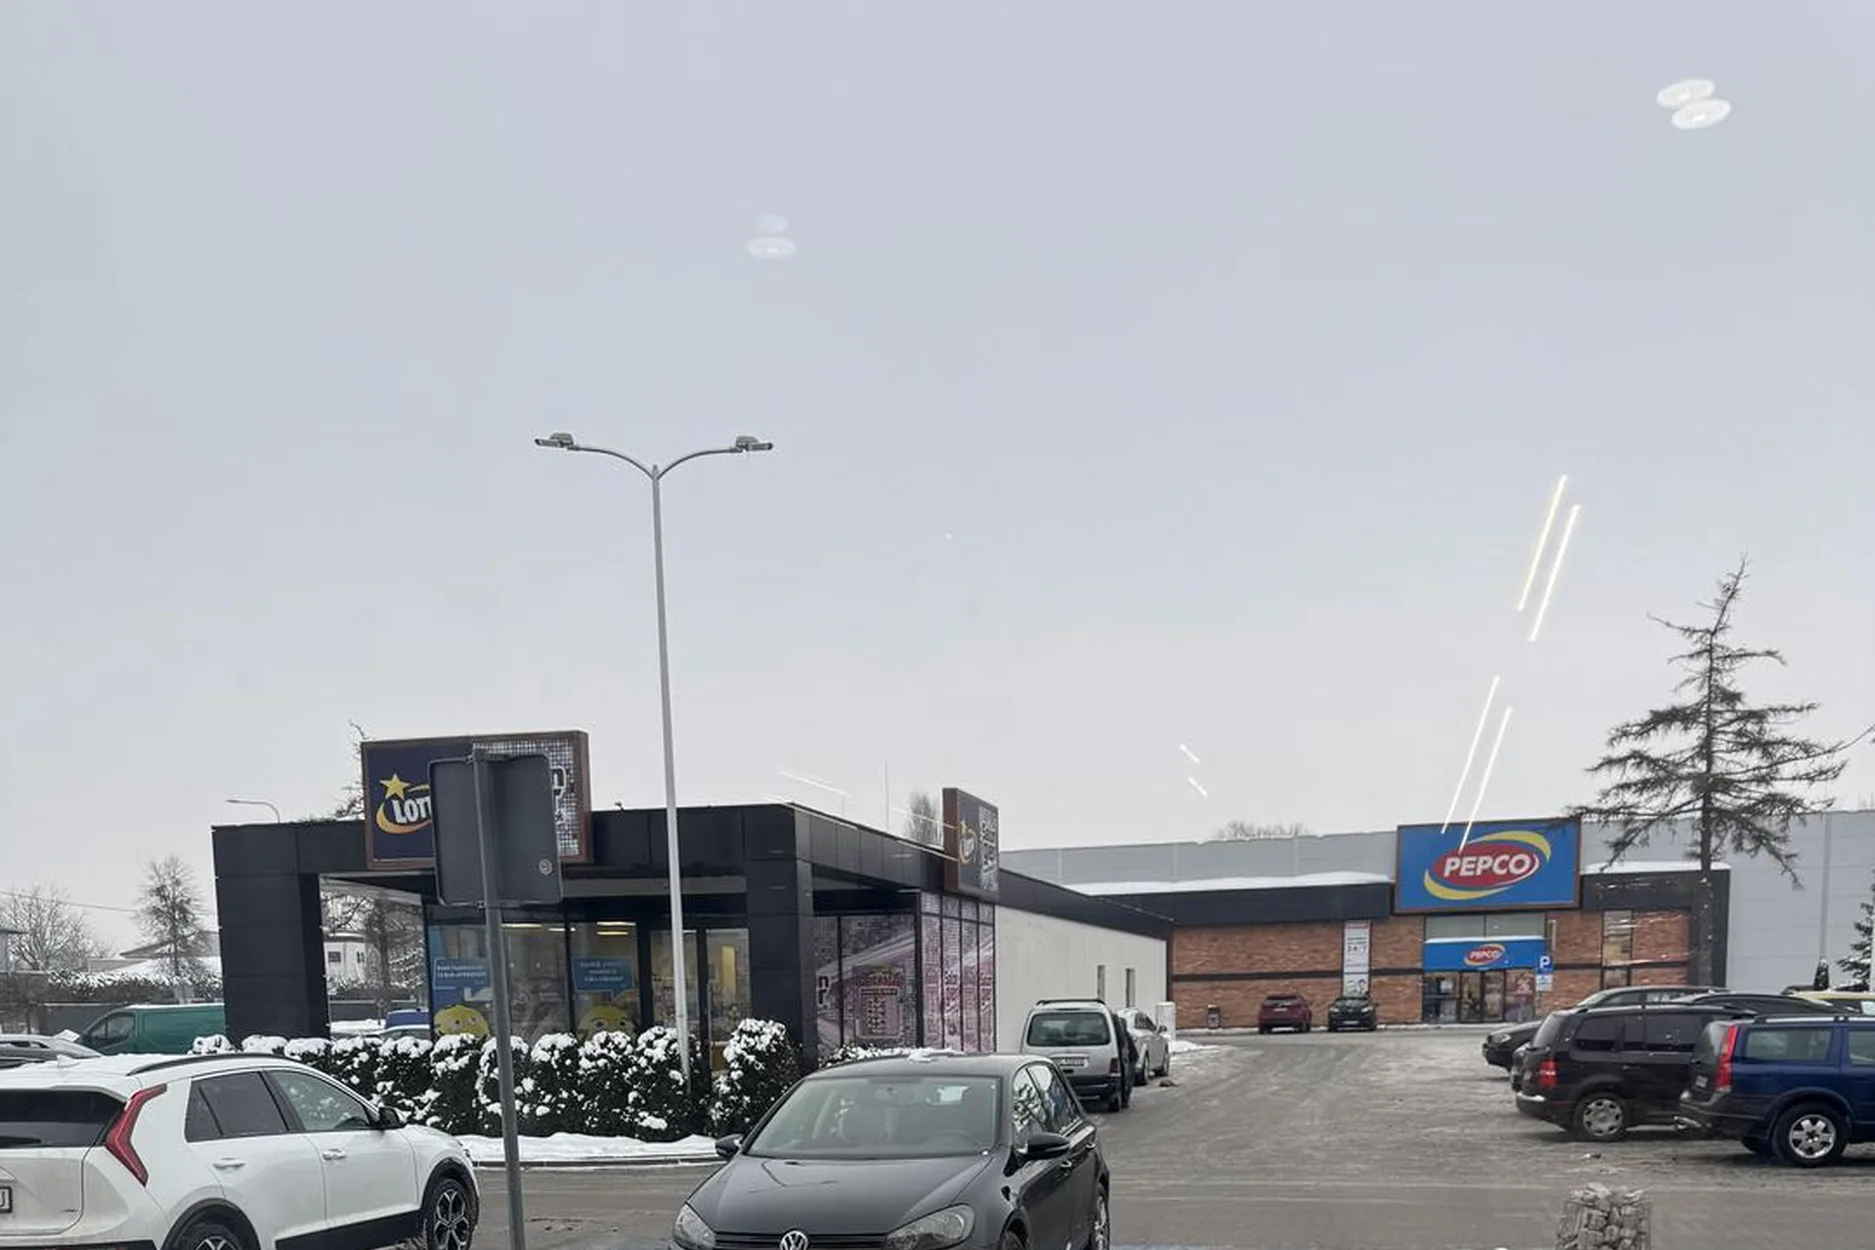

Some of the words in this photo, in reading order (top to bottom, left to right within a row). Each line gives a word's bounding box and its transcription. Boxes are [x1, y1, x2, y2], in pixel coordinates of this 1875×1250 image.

[1443, 853, 1532, 877] PEPCO
[1469, 949, 1502, 960] PEPCO
[1539, 955, 1550, 969] P
